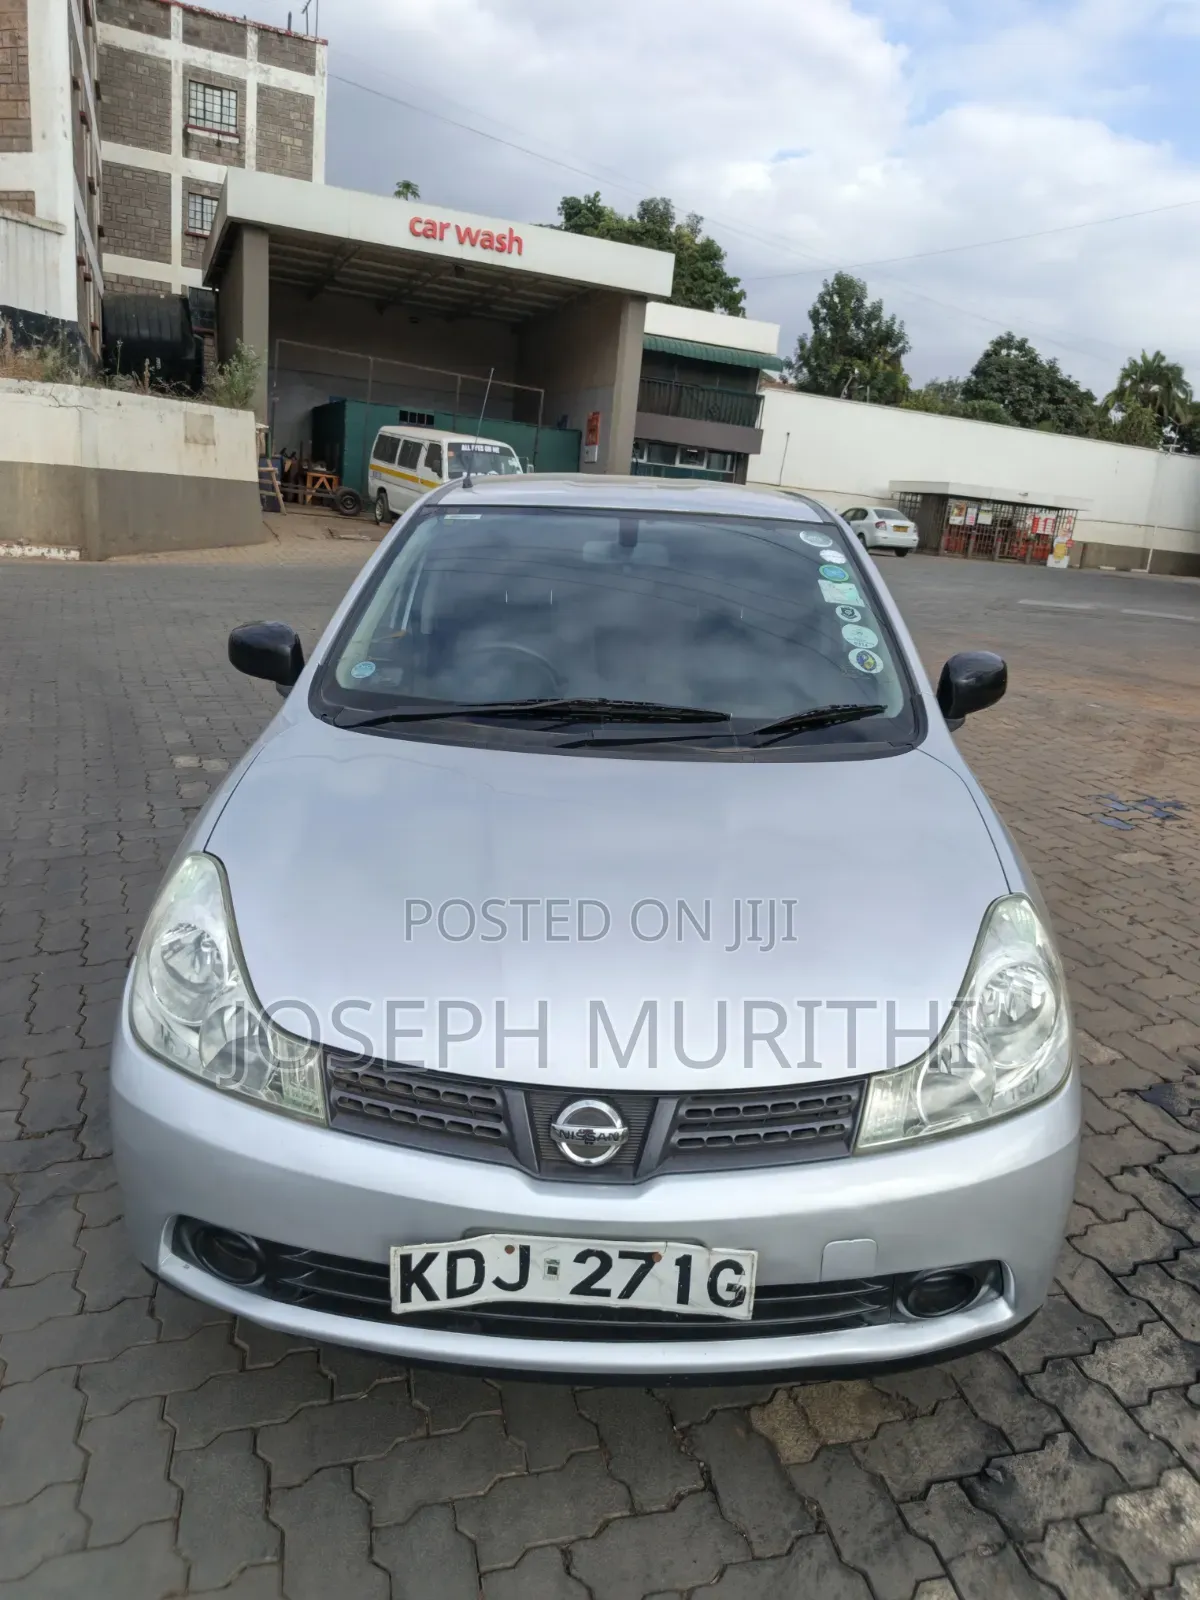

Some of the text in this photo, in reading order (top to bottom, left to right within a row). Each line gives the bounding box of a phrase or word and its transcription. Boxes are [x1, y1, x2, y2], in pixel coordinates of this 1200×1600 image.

[409, 217, 523, 256] car wash
[399, 1244, 747, 1308] KDJ 271G
